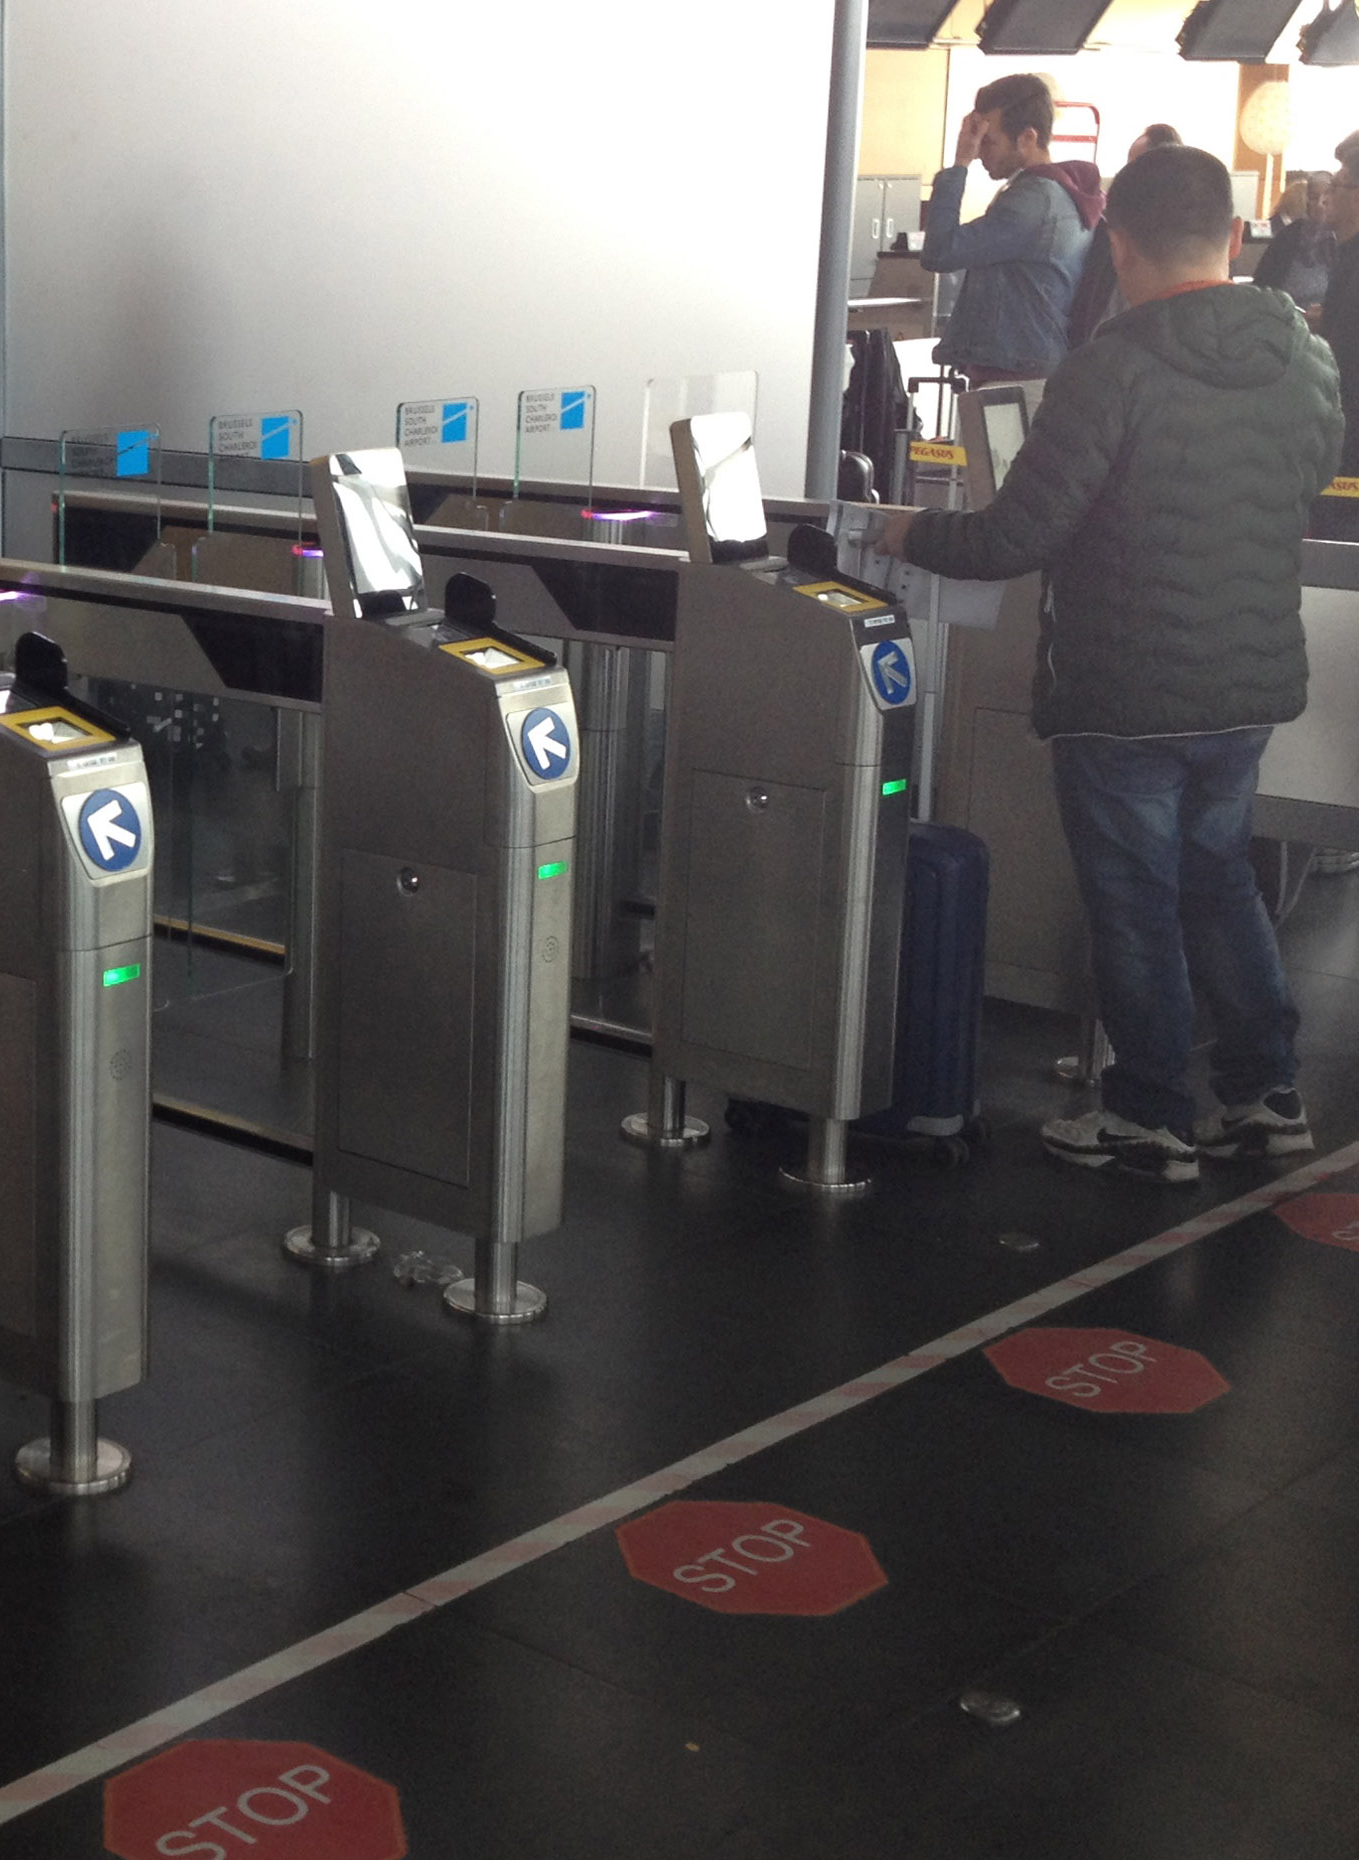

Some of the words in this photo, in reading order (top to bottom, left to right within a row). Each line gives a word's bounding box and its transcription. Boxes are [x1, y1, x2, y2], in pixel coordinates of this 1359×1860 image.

[405, 404, 435, 415] BRUSSELS
[404, 416, 427, 426] SOUTH
[219, 431, 244, 441] SOUTH
[404, 436, 432, 447] AIRPORT
[1044, 1340, 1157, 1398] STOP
[672, 1518, 811, 1593] STOP
[154, 1763, 332, 1860] STOP
